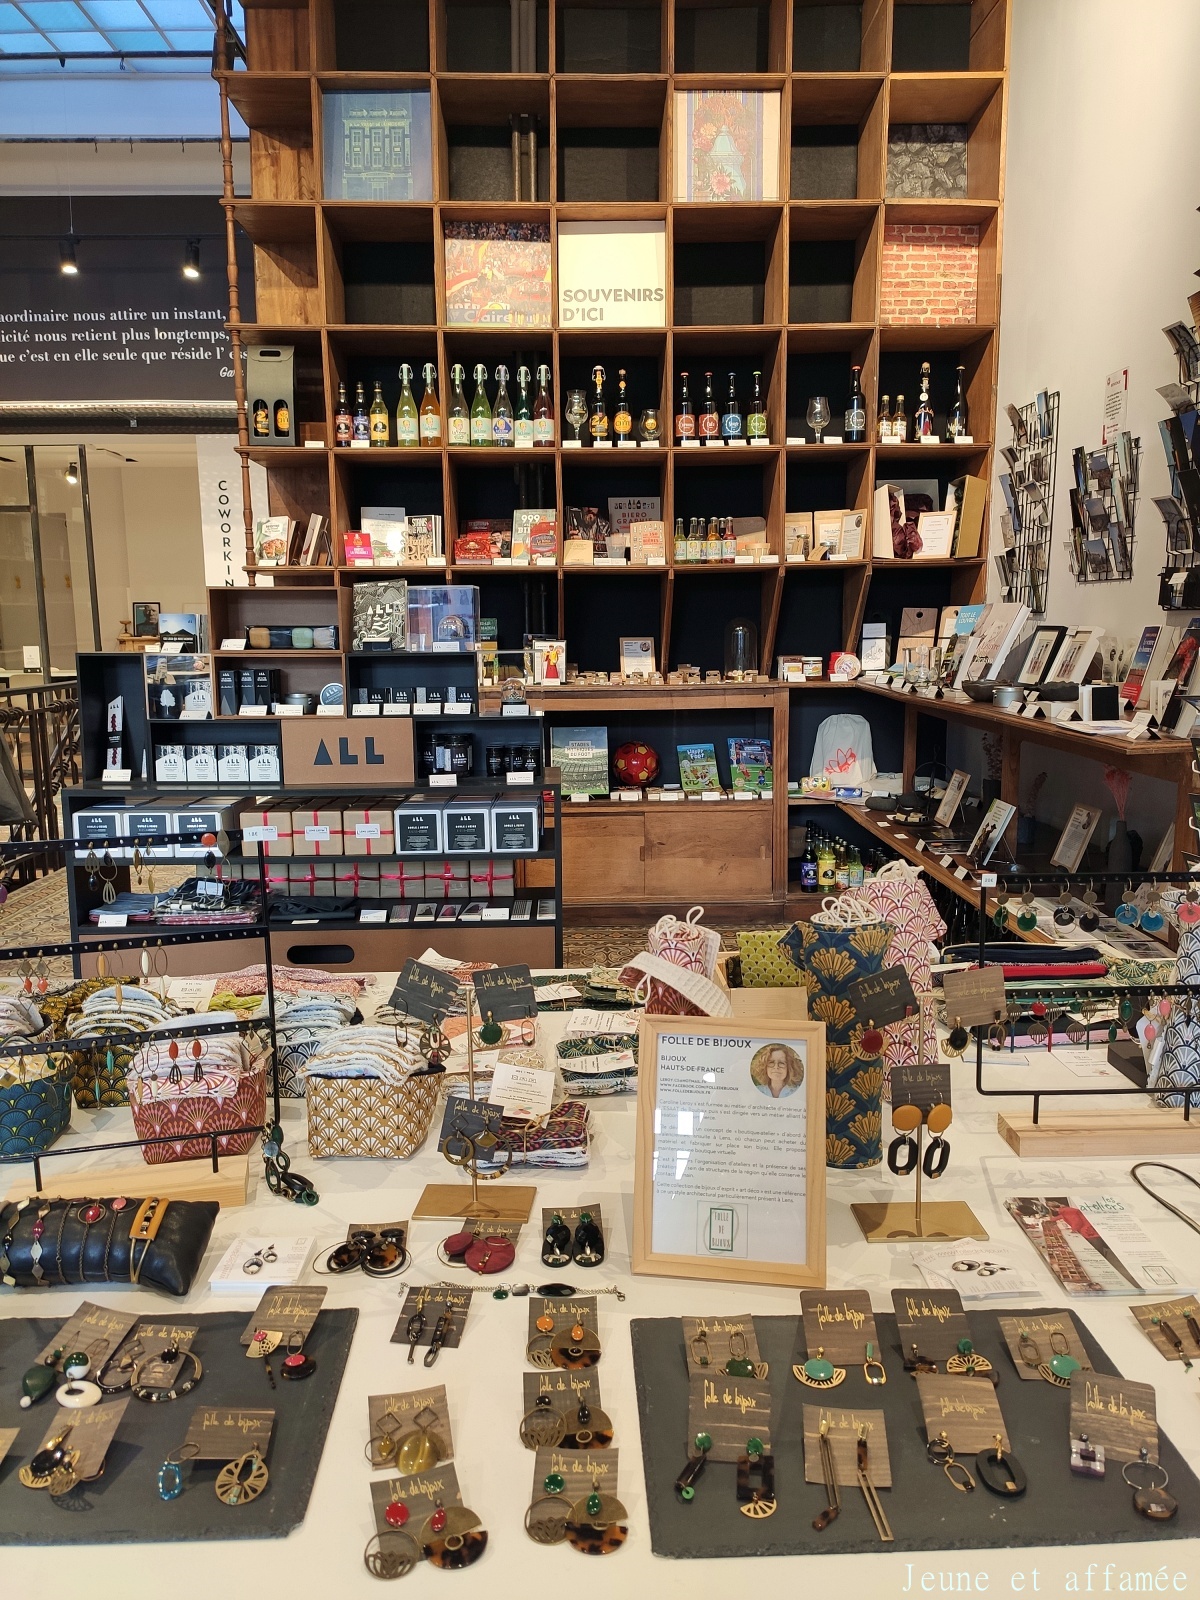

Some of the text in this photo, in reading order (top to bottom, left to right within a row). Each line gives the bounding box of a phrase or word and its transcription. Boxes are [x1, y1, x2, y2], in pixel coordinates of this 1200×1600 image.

[562, 287, 664, 303] SOUVENIRS
[74, 311, 105, 321] nous
[110, 308, 147, 320] attire
[152, 310, 169, 320] un
[174, 308, 226, 321] instant,
[562, 307, 604, 322] D'ICI
[35, 331, 67, 342] nous
[72, 328, 117, 341] retient
[121, 328, 150, 344] plus
[155, 327, 230, 343] longtemps,
[19, 349, 50, 362] c'est
[54, 352, 70, 362] en
[75, 348, 99, 361] elle
[103, 348, 137, 361] seule
[142, 351, 166, 364] que
[171, 347, 212, 360] réside
[521, 514, 540, 523] 999
[218, 480, 234, 587] COWORKIN
[313, 736, 384, 765] ALL
[482, 974, 496, 990] folle
[497, 976, 505, 985] de
[859, 982, 874, 1002] folle
[874, 982, 881, 993] de
[662, 1036, 751, 1048] FOLLE DE BIJOUX
[660, 1064, 724, 1073] HAUTS-DE-FRANCE
[916, 1072, 924, 1082] de
[454, 1100, 468, 1115] folle
[471, 1105, 479, 1114] de
[1080, 1201, 1125, 1211] ateliers
[1102, 1196, 1115, 1204] les
[719, 1225, 724, 1234] DE
[283, 1298, 292, 1315] de
[544, 1298, 557, 1317] folle
[560, 1304, 568, 1313] de
[906, 1297, 920, 1322] folle
[922, 1301, 931, 1316] de
[817, 1303, 844, 1330] folle de
[158, 1326, 168, 1337] de
[714, 1320, 722, 1331] de
[540, 1374, 553, 1397] folle
[557, 1377, 566, 1391] de
[704, 1379, 719, 1409] folle
[723, 1388, 733, 1404] de
[1085, 1381, 1120, 1414] folle de
[401, 1396, 410, 1411] de
[954, 1398, 964, 1413] de
[203, 1412, 219, 1431] folle
[224, 1414, 234, 1426] de
[839, 1414, 849, 1428] de
[551, 1454, 570, 1475] folle
[572, 1455, 584, 1472] de
[389, 1479, 407, 1502] folle
[409, 1477, 420, 1495] de
